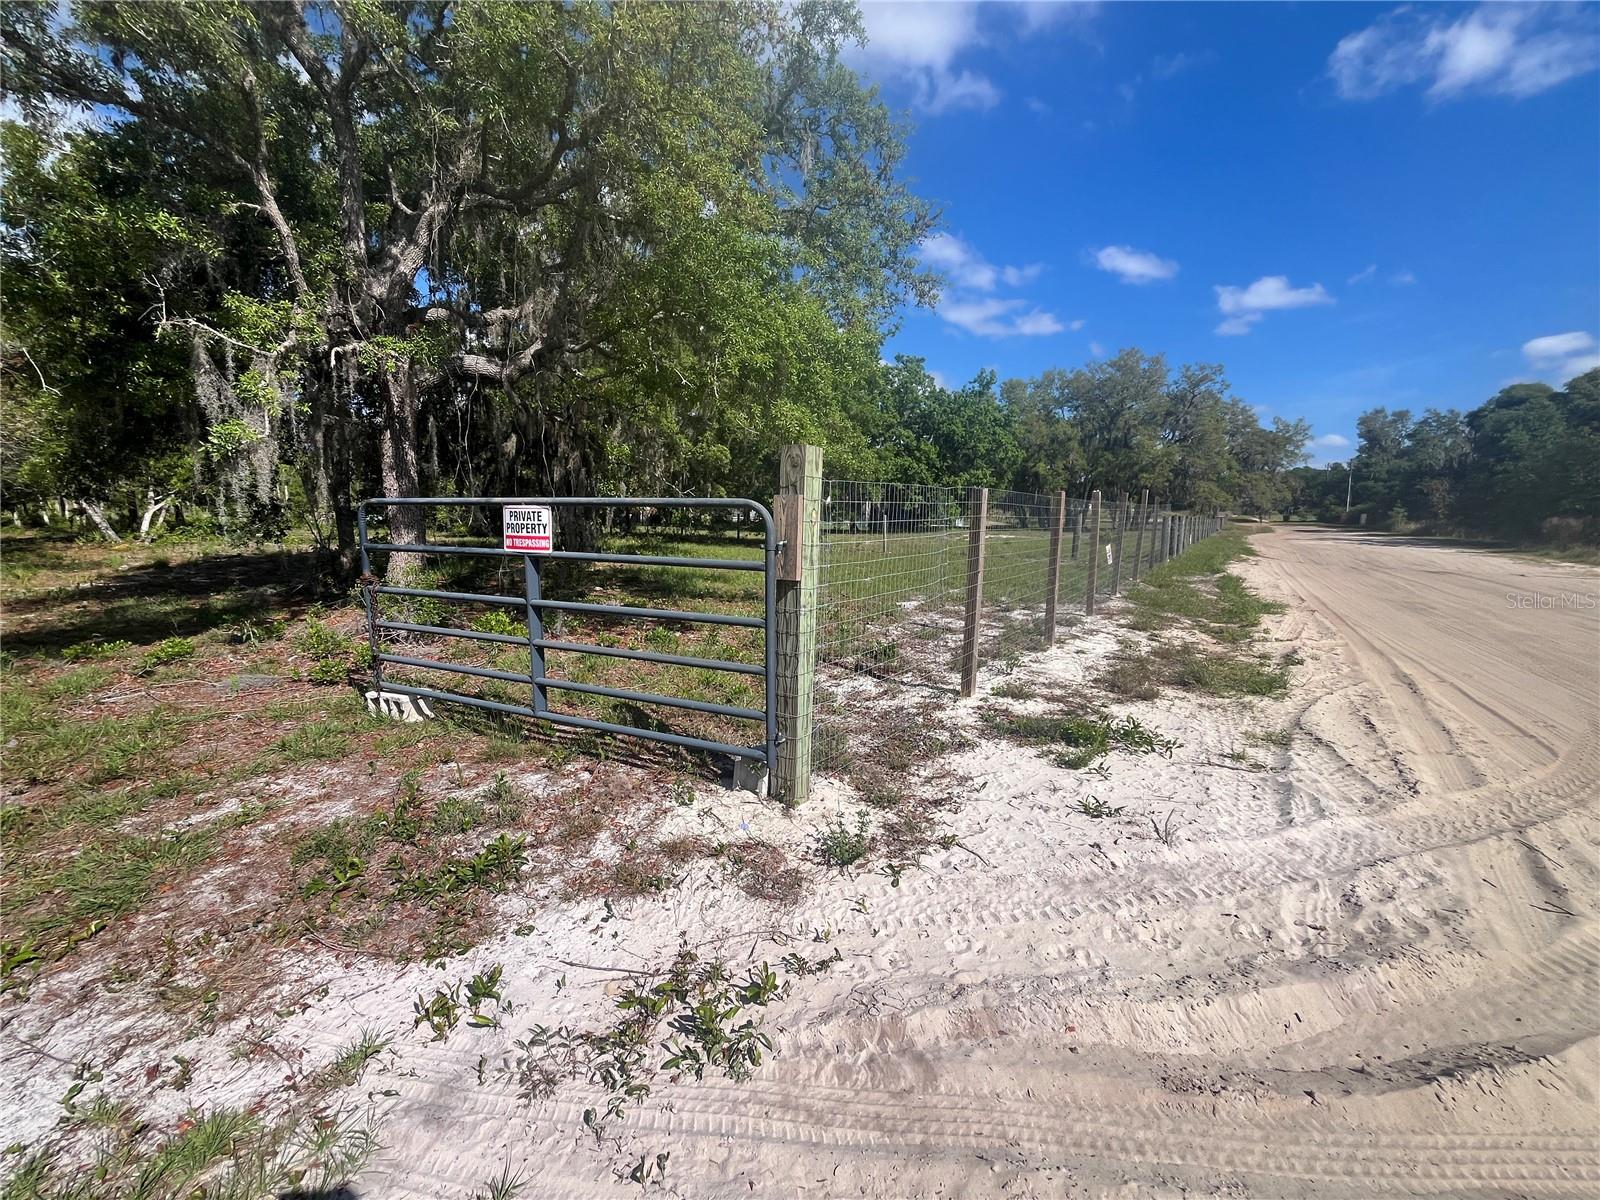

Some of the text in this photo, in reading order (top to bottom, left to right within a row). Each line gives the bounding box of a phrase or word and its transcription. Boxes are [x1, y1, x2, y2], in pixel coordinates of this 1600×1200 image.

[509, 510, 542, 522] PRIVATE
[506, 523, 547, 534] PROPERTY
[506, 537, 549, 548] NO TRESPASSING
